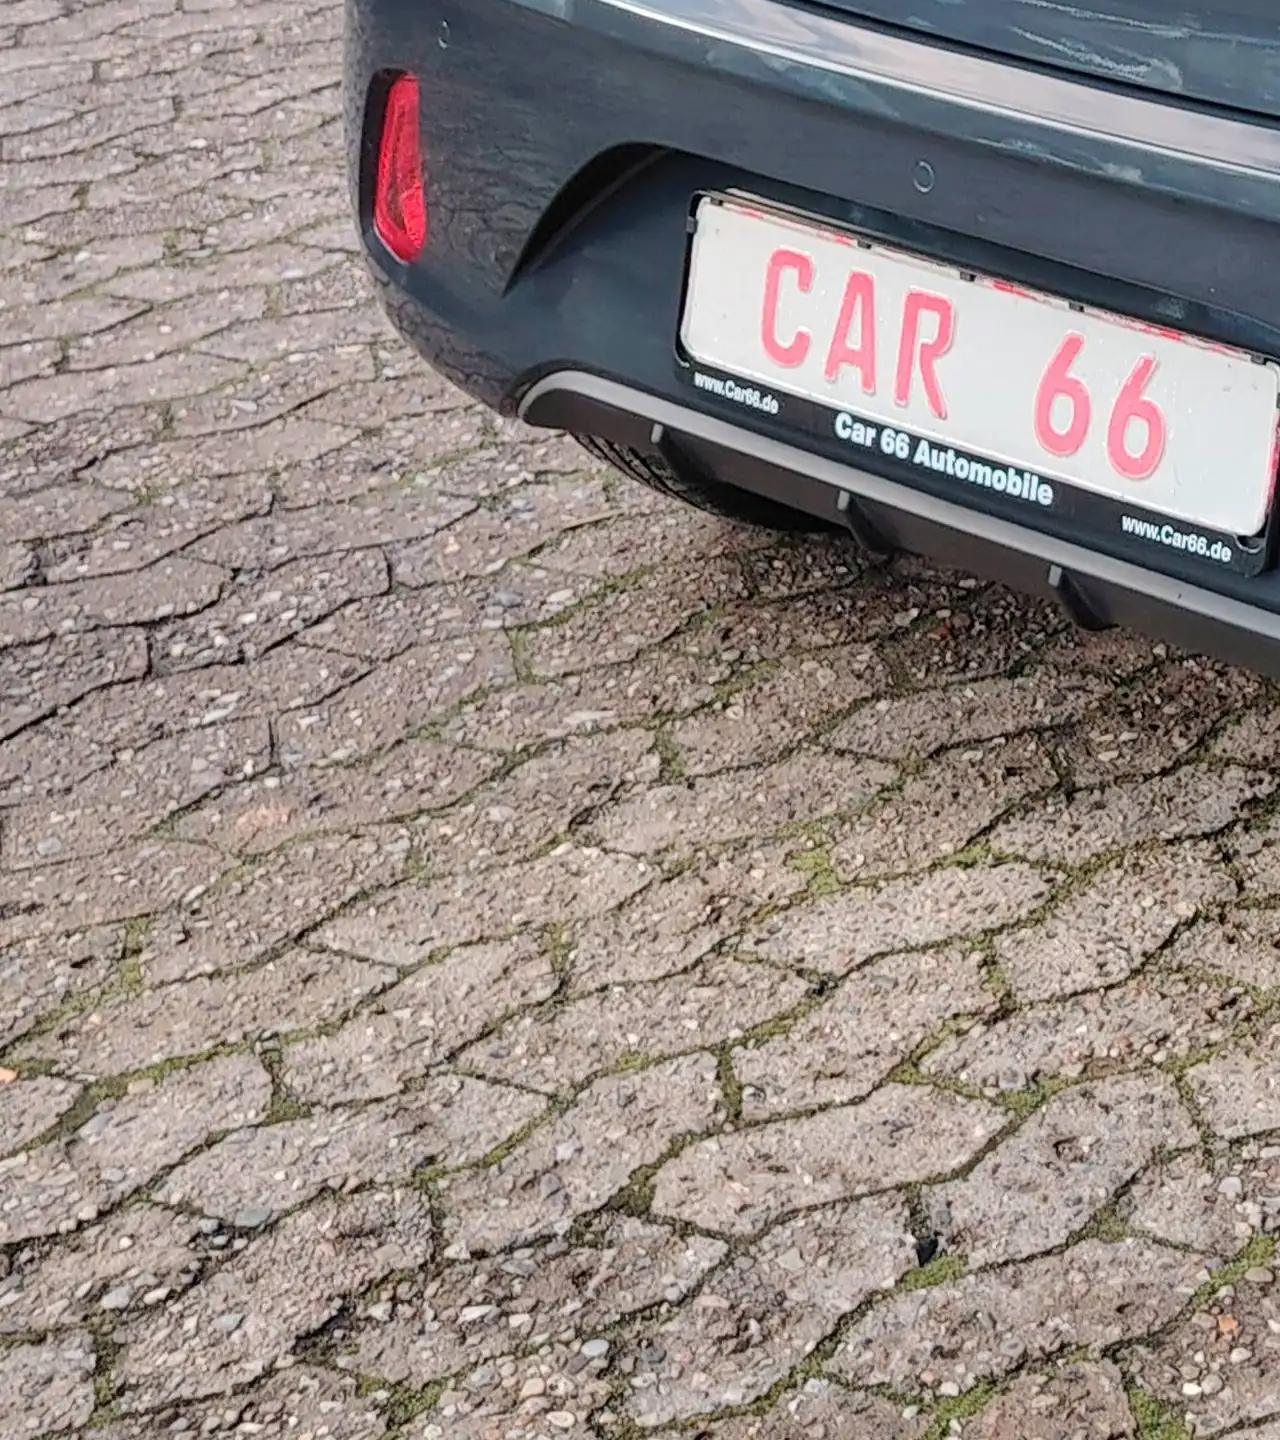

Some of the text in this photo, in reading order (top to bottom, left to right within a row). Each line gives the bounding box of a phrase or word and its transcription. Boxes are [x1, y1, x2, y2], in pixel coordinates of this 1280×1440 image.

[693, 371, 779, 415] www.Car66.de
[761, 245, 1167, 479] CAR 66
[834, 412, 1054, 506] Car 66 Automobile
[1121, 515, 1233, 563] www.Car66.de
